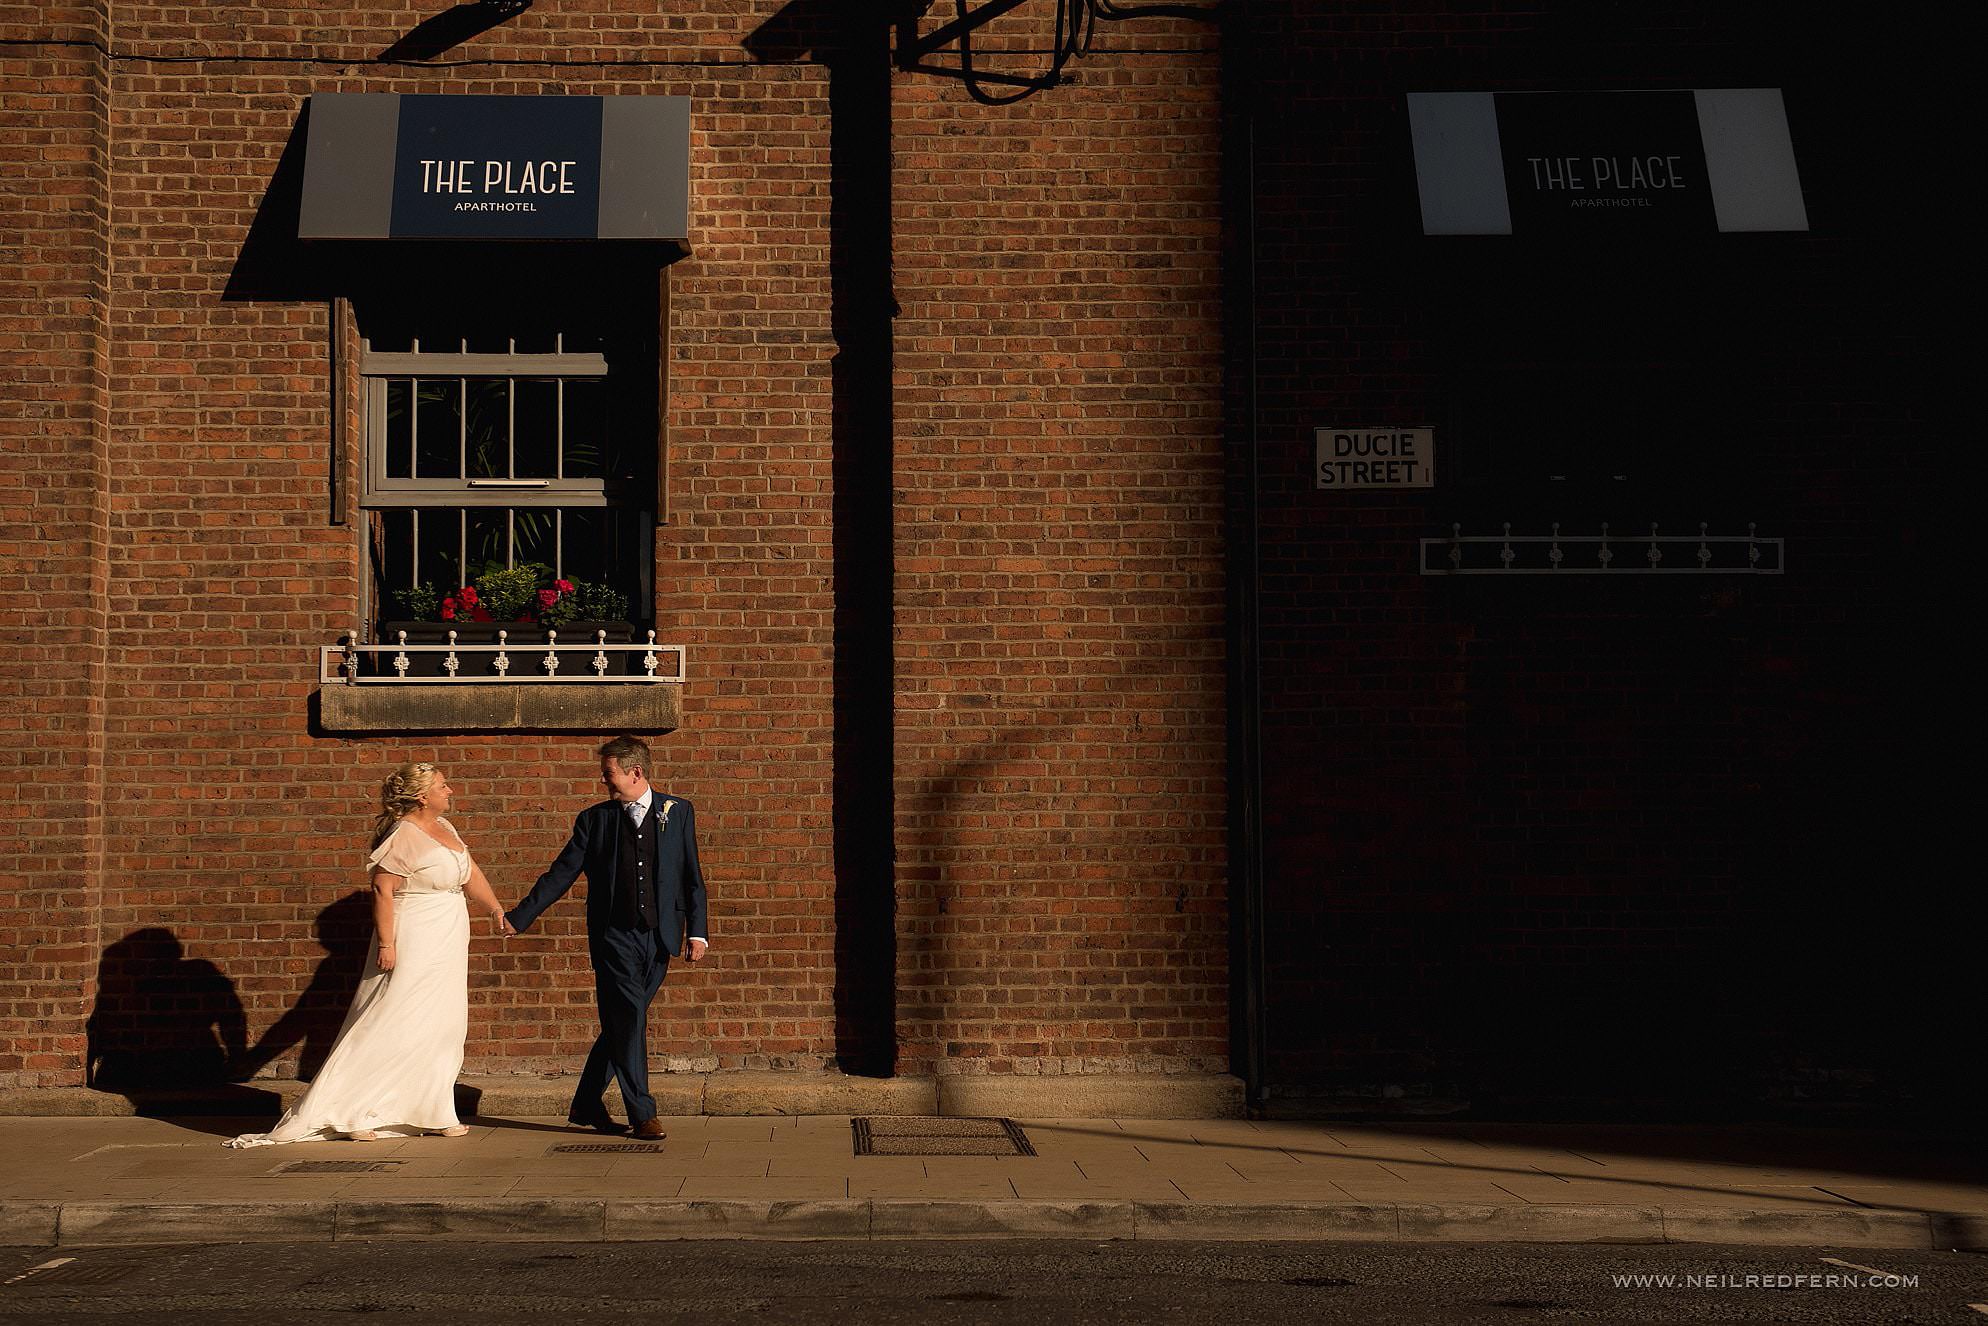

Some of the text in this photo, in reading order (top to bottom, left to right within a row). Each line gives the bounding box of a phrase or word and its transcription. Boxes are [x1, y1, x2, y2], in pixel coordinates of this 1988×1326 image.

[420, 160, 577, 194] THE PLACE
[1527, 155, 1687, 191] THE PLACE
[454, 202, 537, 212] APARTHOTEL
[1570, 197, 1653, 209] APARTHOTEL
[1334, 433, 1415, 457] DUCIE
[1320, 460, 1418, 484] STREET
